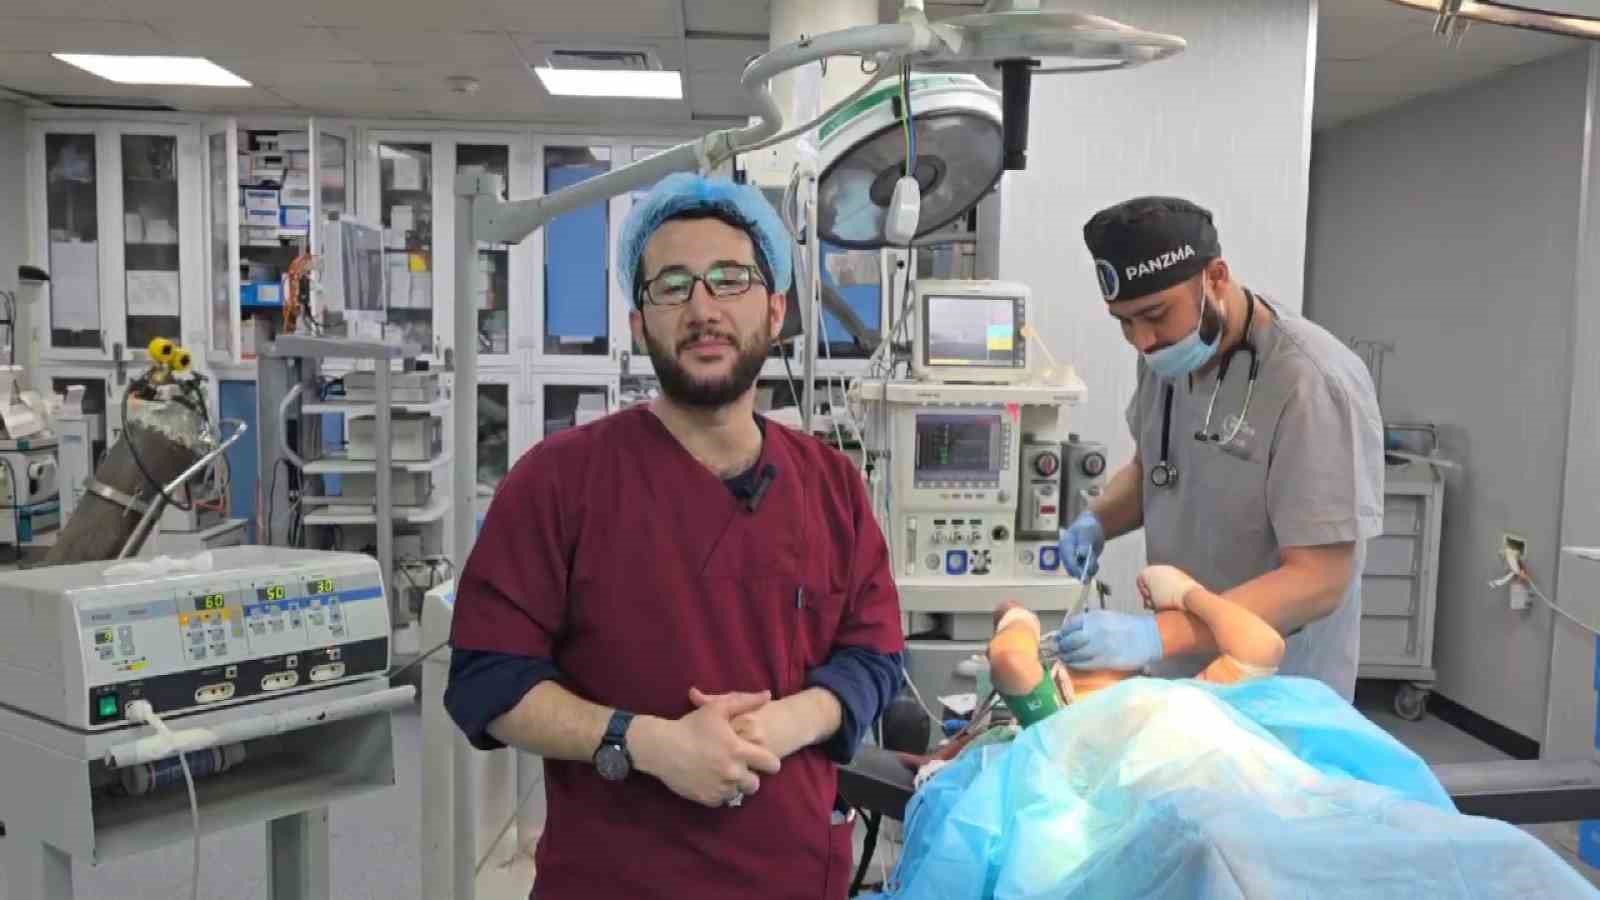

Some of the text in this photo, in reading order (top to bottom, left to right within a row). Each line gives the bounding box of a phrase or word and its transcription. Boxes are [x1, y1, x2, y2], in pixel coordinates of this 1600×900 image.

[1125, 244, 1196, 281] PANZMA
[266, 585, 285, 600] 50
[205, 593, 224, 609] 60
